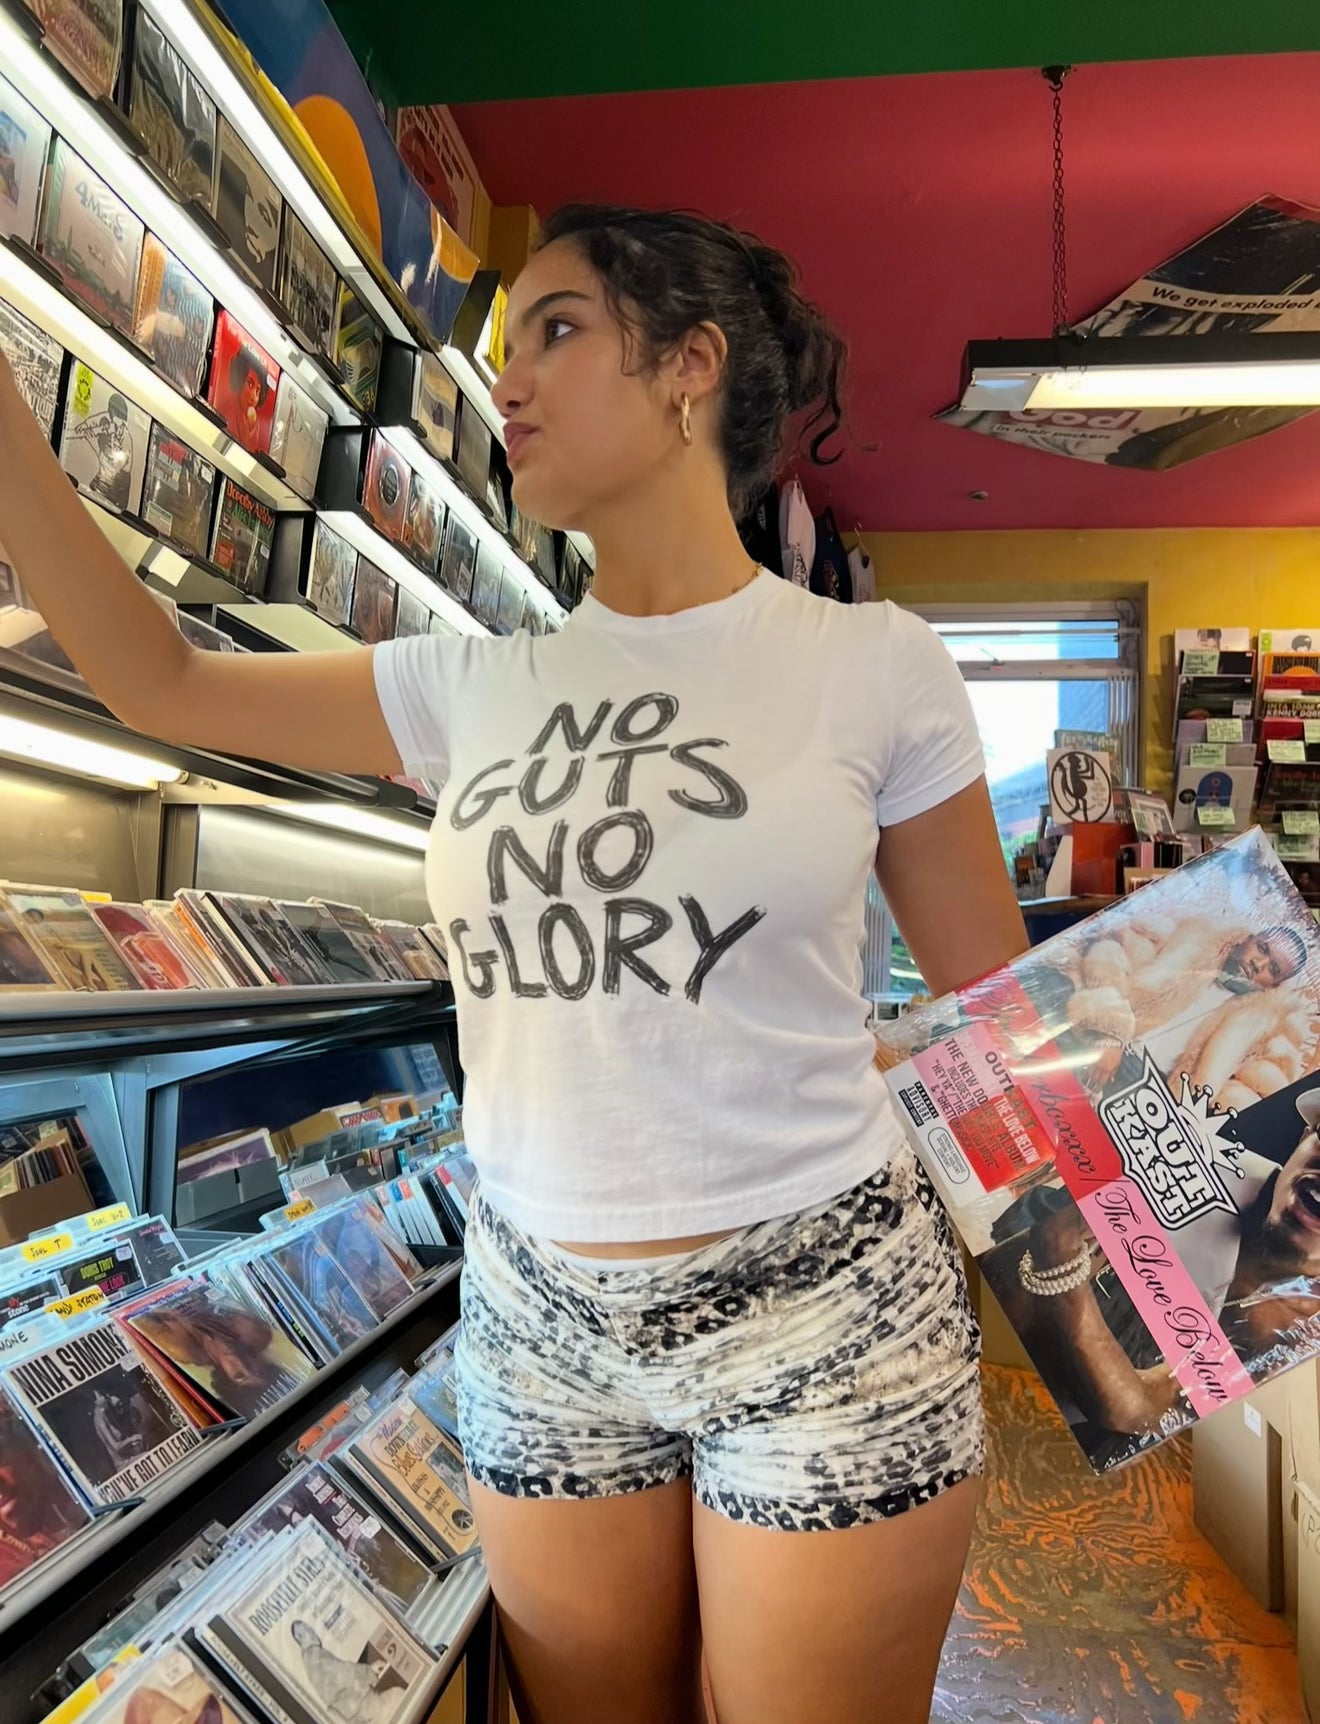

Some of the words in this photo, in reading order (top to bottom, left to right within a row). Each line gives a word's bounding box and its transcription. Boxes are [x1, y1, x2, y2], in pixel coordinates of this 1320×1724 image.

[1152, 287, 1181, 301] We
[1183, 296, 1218, 308] get
[1220, 298, 1314, 311] exploded
[1014, 426, 1049, 437] their
[526, 692, 679, 757] NO
[1266, 710, 1297, 719] KENNY
[450, 738, 748, 832] GUTS
[487, 809, 654, 905] NO
[449, 894, 767, 1005] GLORY
[905, 1084, 932, 1122] ADVISORY
[929, 1083, 940, 1093] &
[944, 1038, 964, 1061] THE
[957, 1060, 979, 1089] NEW
[996, 1130, 1026, 1171] ALBUM
[945, 1065, 971, 1100] INCLUDES
[983, 1049, 1037, 1131] OUTKAST
[993, 1096, 1012, 1116] THE
[1002, 1113, 1024, 1137] LOVE
[1014, 1132, 1040, 1165] BELOW
[1135, 1087, 1217, 1209] OUT
[1109, 1097, 1192, 1218] KAST
[54, 1238, 62, 1250] T
[79, 1263, 99, 1280] DORIS
[98, 1257, 115, 1275] TROY
[1095, 1186, 1141, 1235] The
[1121, 1234, 1173, 1306] Love
[1164, 1306, 1229, 1403] Below
[10, 1355, 73, 1406] NINA
[56, 1323, 131, 1382] SIMONE
[134, 1455, 159, 1483] GOT
[155, 1446, 173, 1469] TO
[166, 1427, 201, 1462] LEARN
[248, 1574, 301, 1637] ROOSEVELT
